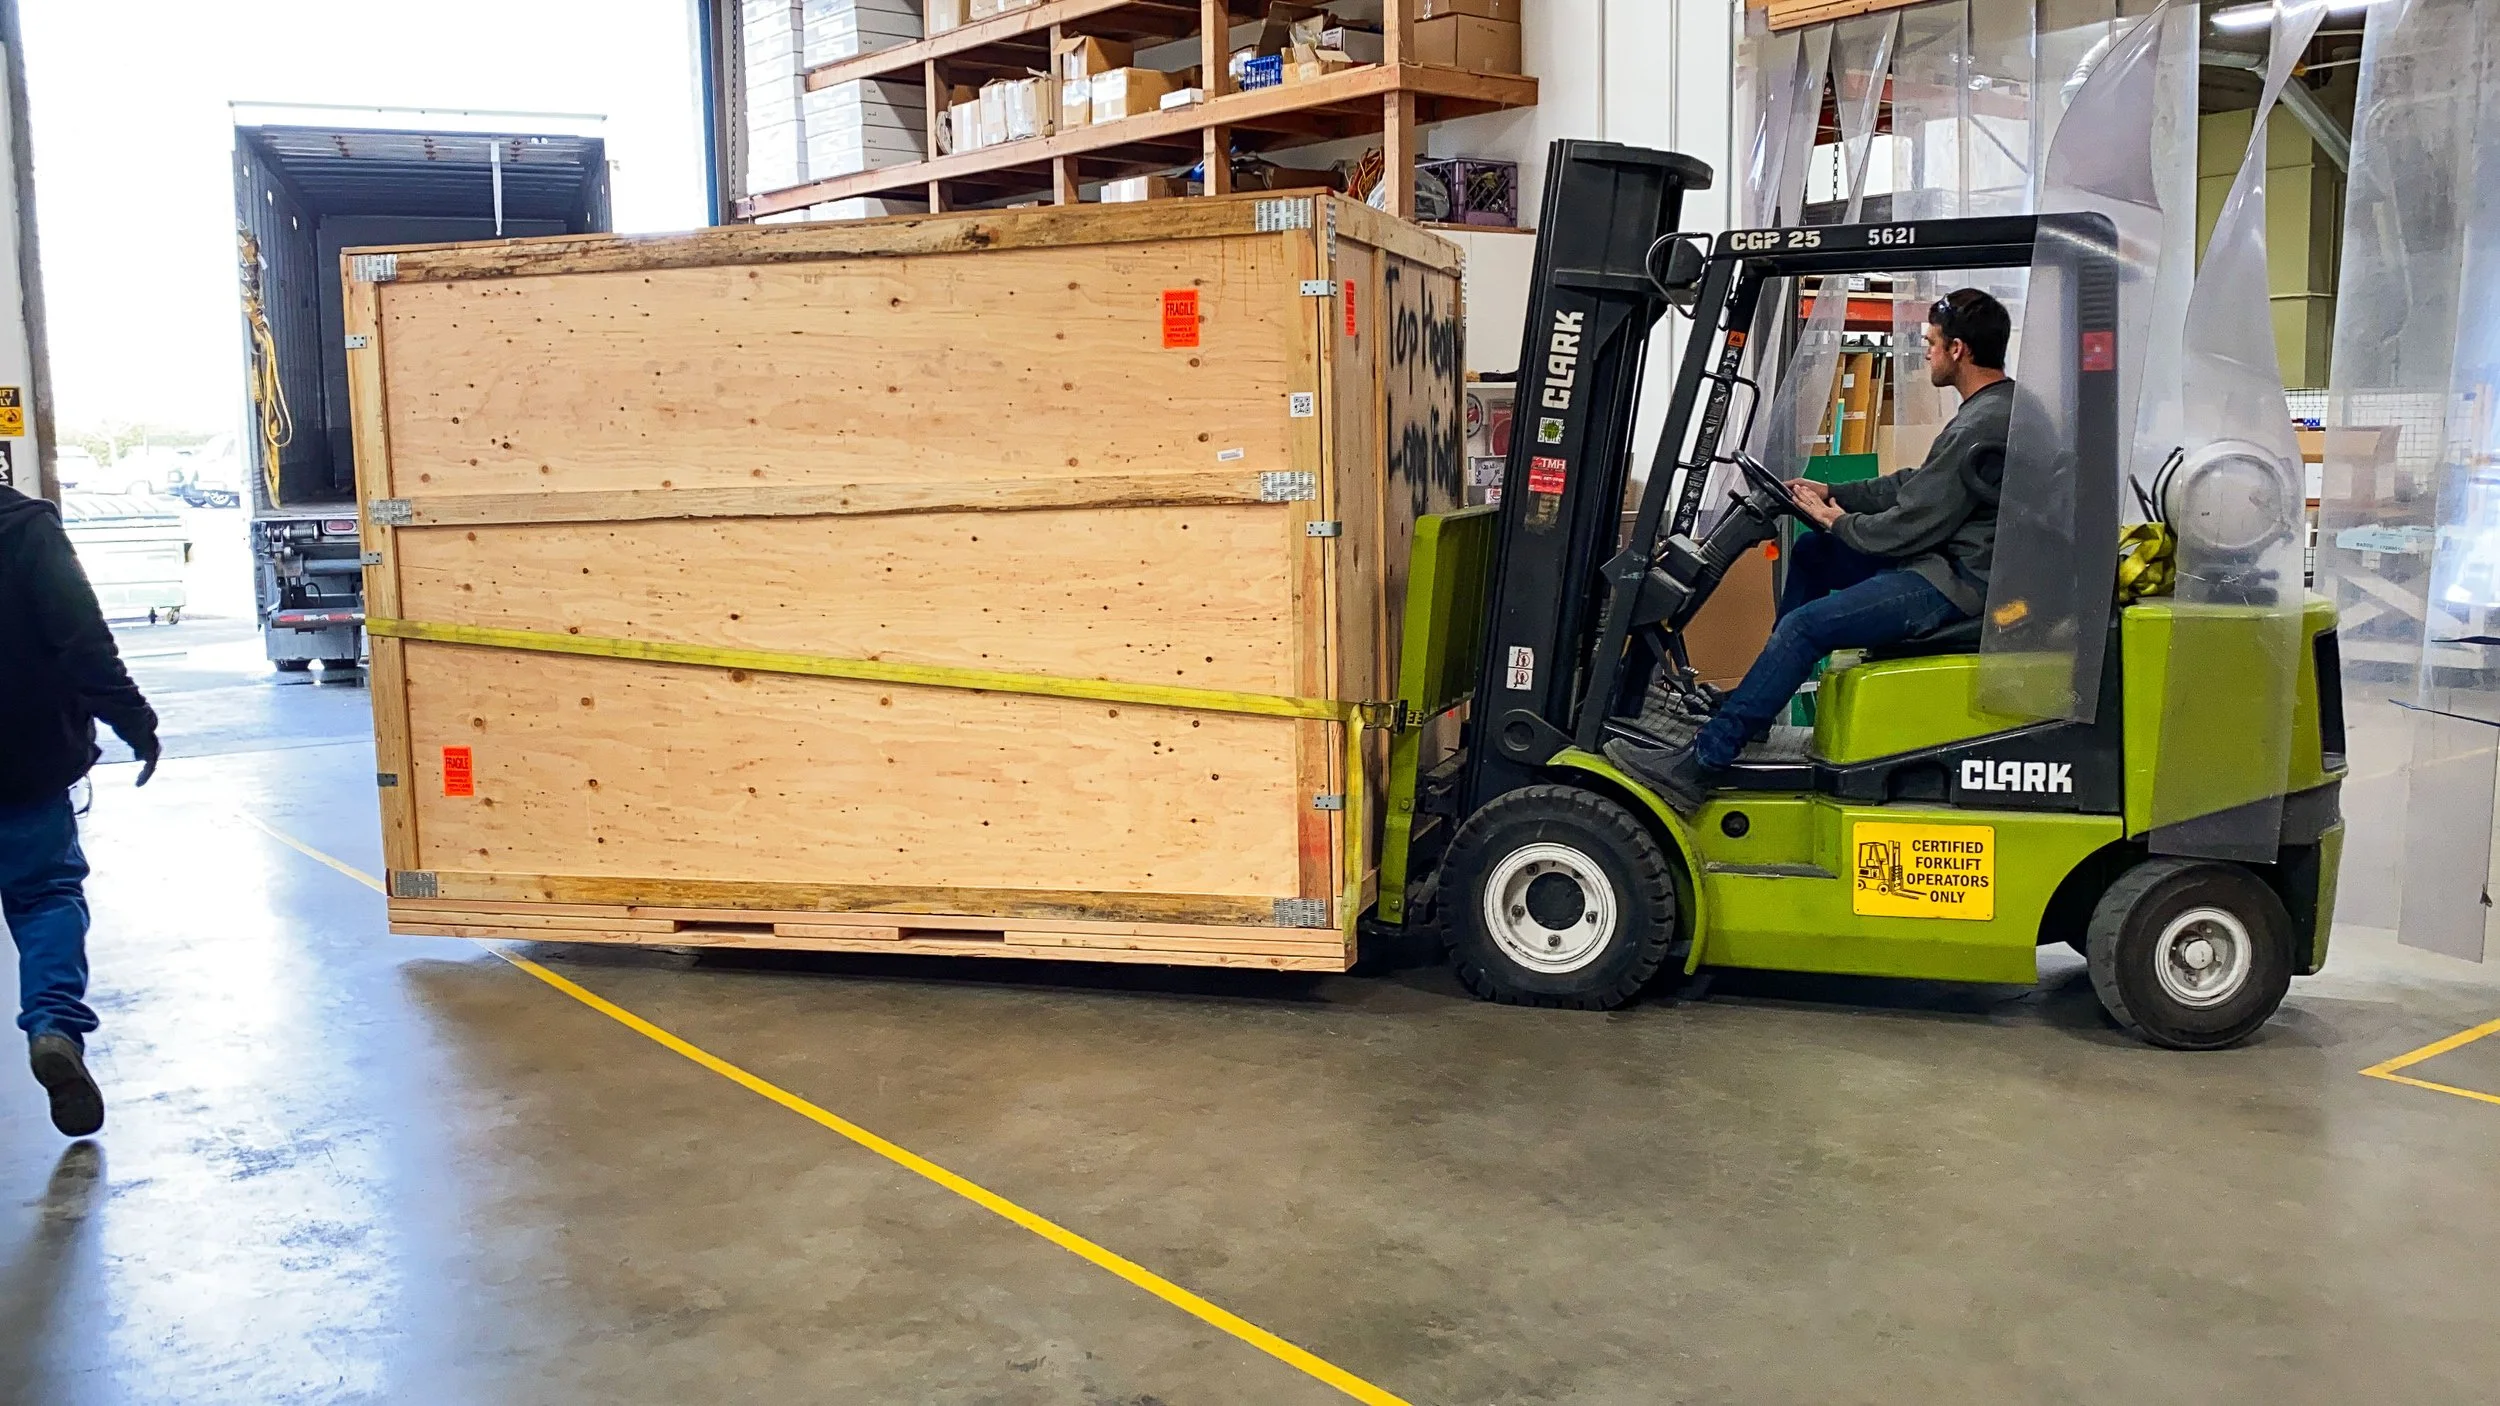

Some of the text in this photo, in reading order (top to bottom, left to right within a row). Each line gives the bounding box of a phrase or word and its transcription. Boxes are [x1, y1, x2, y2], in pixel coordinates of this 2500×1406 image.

[1730, 230, 1821, 251] CGP 25
[1867, 227, 1915, 246] 5621
[1165, 302, 1195, 316] FRAGILE
[1386, 267, 1419, 396] Top
[1542, 309, 1584, 410] CLARK
[0, 398, 11, 406] LY
[1542, 458, 1566, 470] TMH
[1961, 759, 2073, 793] CLARK
[1912, 839, 1984, 854] CERTIFIED
[1915, 856, 1982, 871] FORKLIFT
[1906, 872, 1989, 888] OPERATORS
[1930, 890, 1965, 903] ONLY
